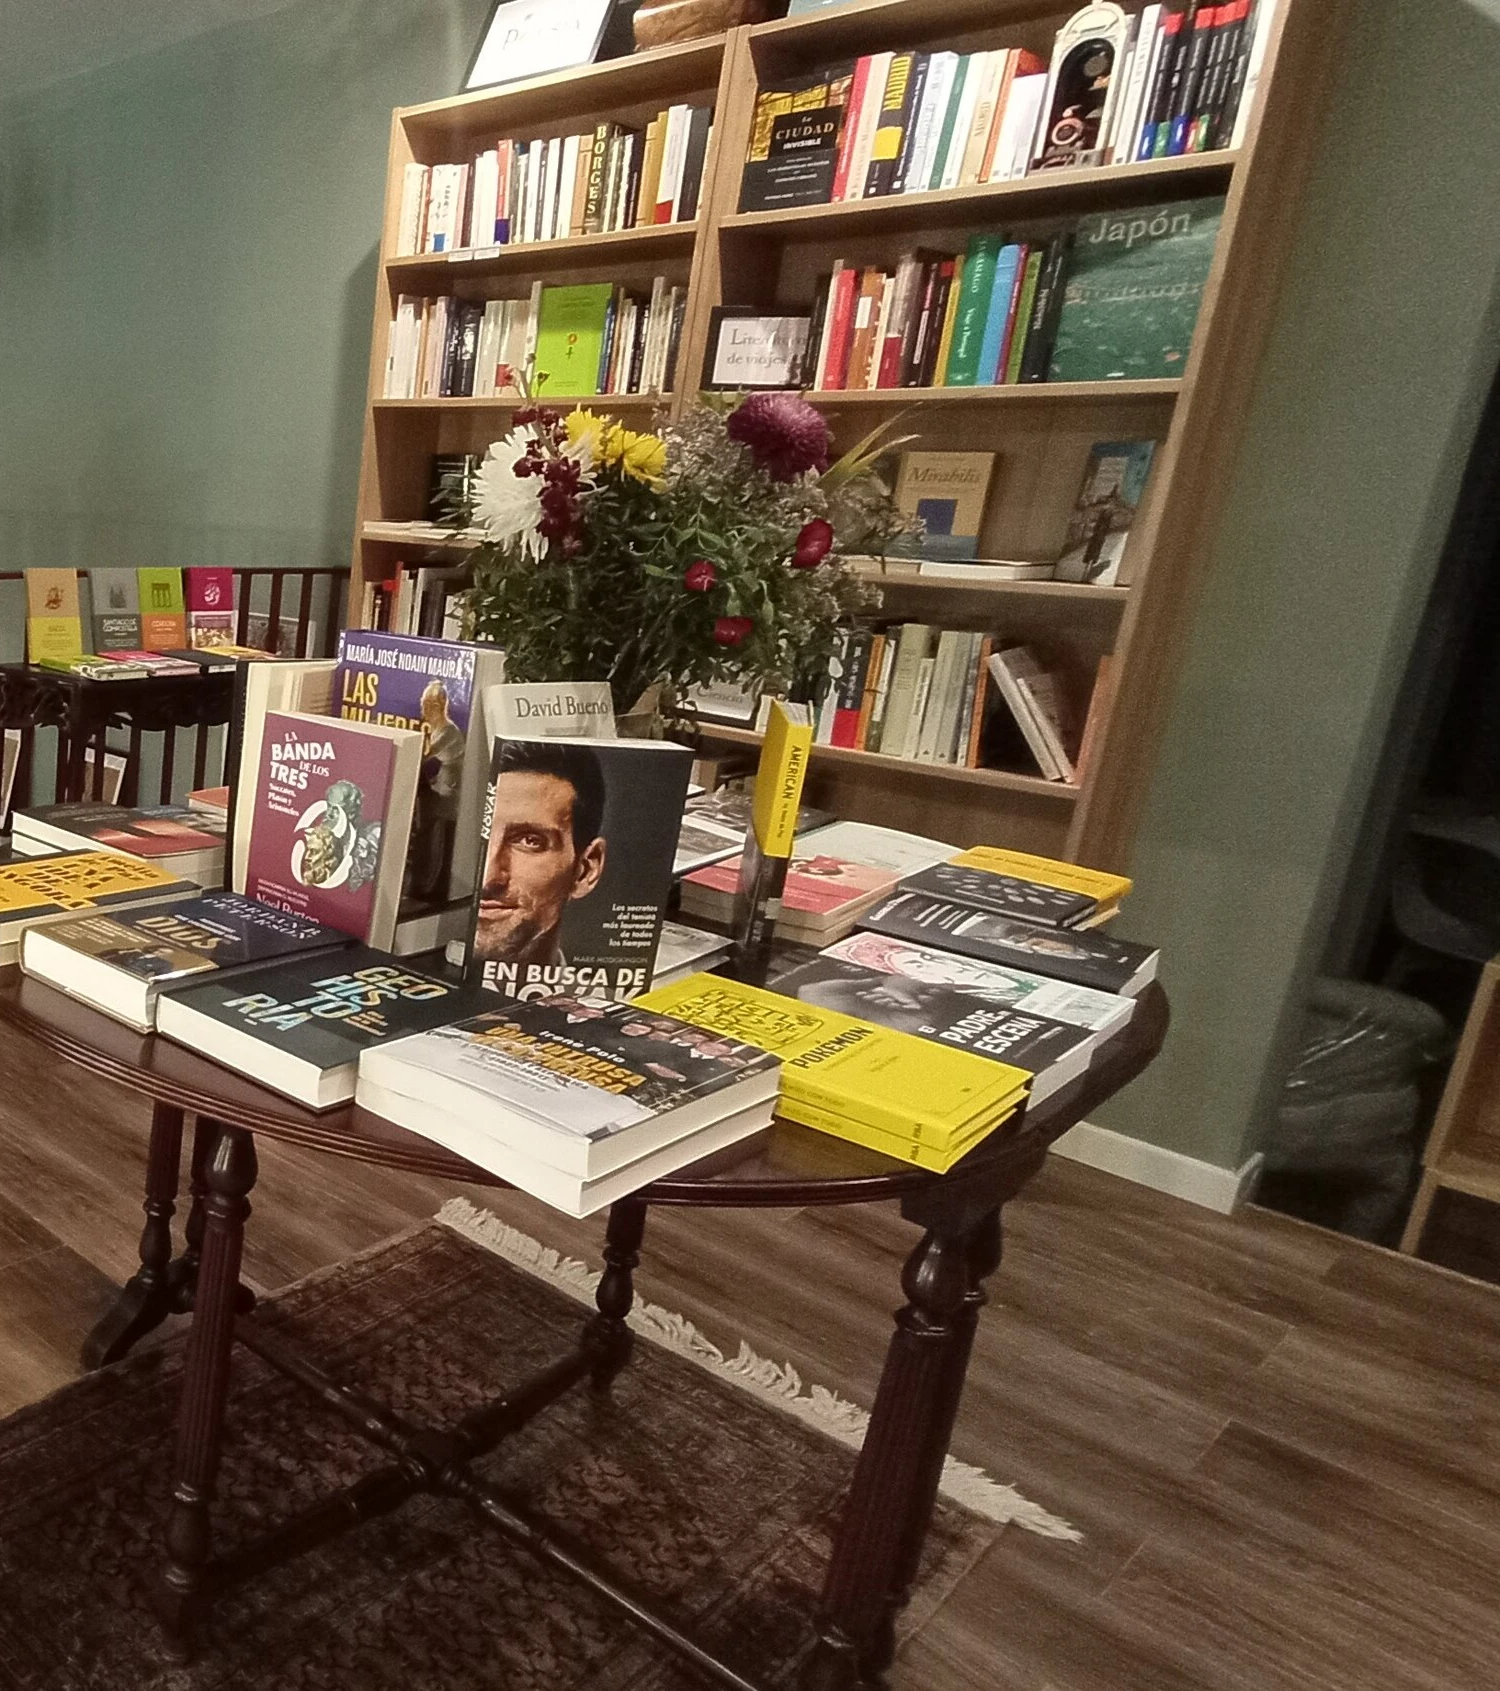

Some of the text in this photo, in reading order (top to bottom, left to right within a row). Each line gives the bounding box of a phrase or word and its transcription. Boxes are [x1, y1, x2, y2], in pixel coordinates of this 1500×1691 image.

[882, 56, 912, 111] MADRID
[775, 122, 835, 140] CIUDAD
[783, 137, 822, 150] INVISIBLE
[586, 125, 608, 215] BORGES
[1088, 209, 1191, 248] Japón
[726, 352, 743, 365] de
[346, 644, 373, 664] MARÍA
[374, 648, 398, 668] JOSÉ
[399, 652, 428, 674] NOAIN
[342, 669, 379, 707] LAS
[515, 696, 608, 718] David Bueno
[271, 742, 335, 761] BANDA
[285, 731, 298, 742] LA
[270, 760, 308, 790] TRES
[299, 760, 330, 777] DE LOS
[782, 745, 803, 800] AMERICAN
[480, 781, 497, 839] NOVAK
[603, 921, 618, 929] más
[617, 912, 630, 920] del
[133, 915, 232, 950] DIOS
[609, 938, 651, 948] los tiempos
[620, 930, 631, 938] de
[353, 966, 448, 1000] GEO
[483, 961, 519, 981] EN
[526, 964, 609, 987] BUSCA
[616, 968, 647, 987] DE
[293, 991, 362, 1019] TO
[310, 974, 398, 1006] HIS
[939, 1008, 1000, 1044] PADRE
[974, 1015, 1046, 1055] ESCENA
[586, 1045, 626, 1064] Polo
[790, 1025, 875, 1070] POKÉMON
[539, 1041, 647, 1087] INTRUSA
